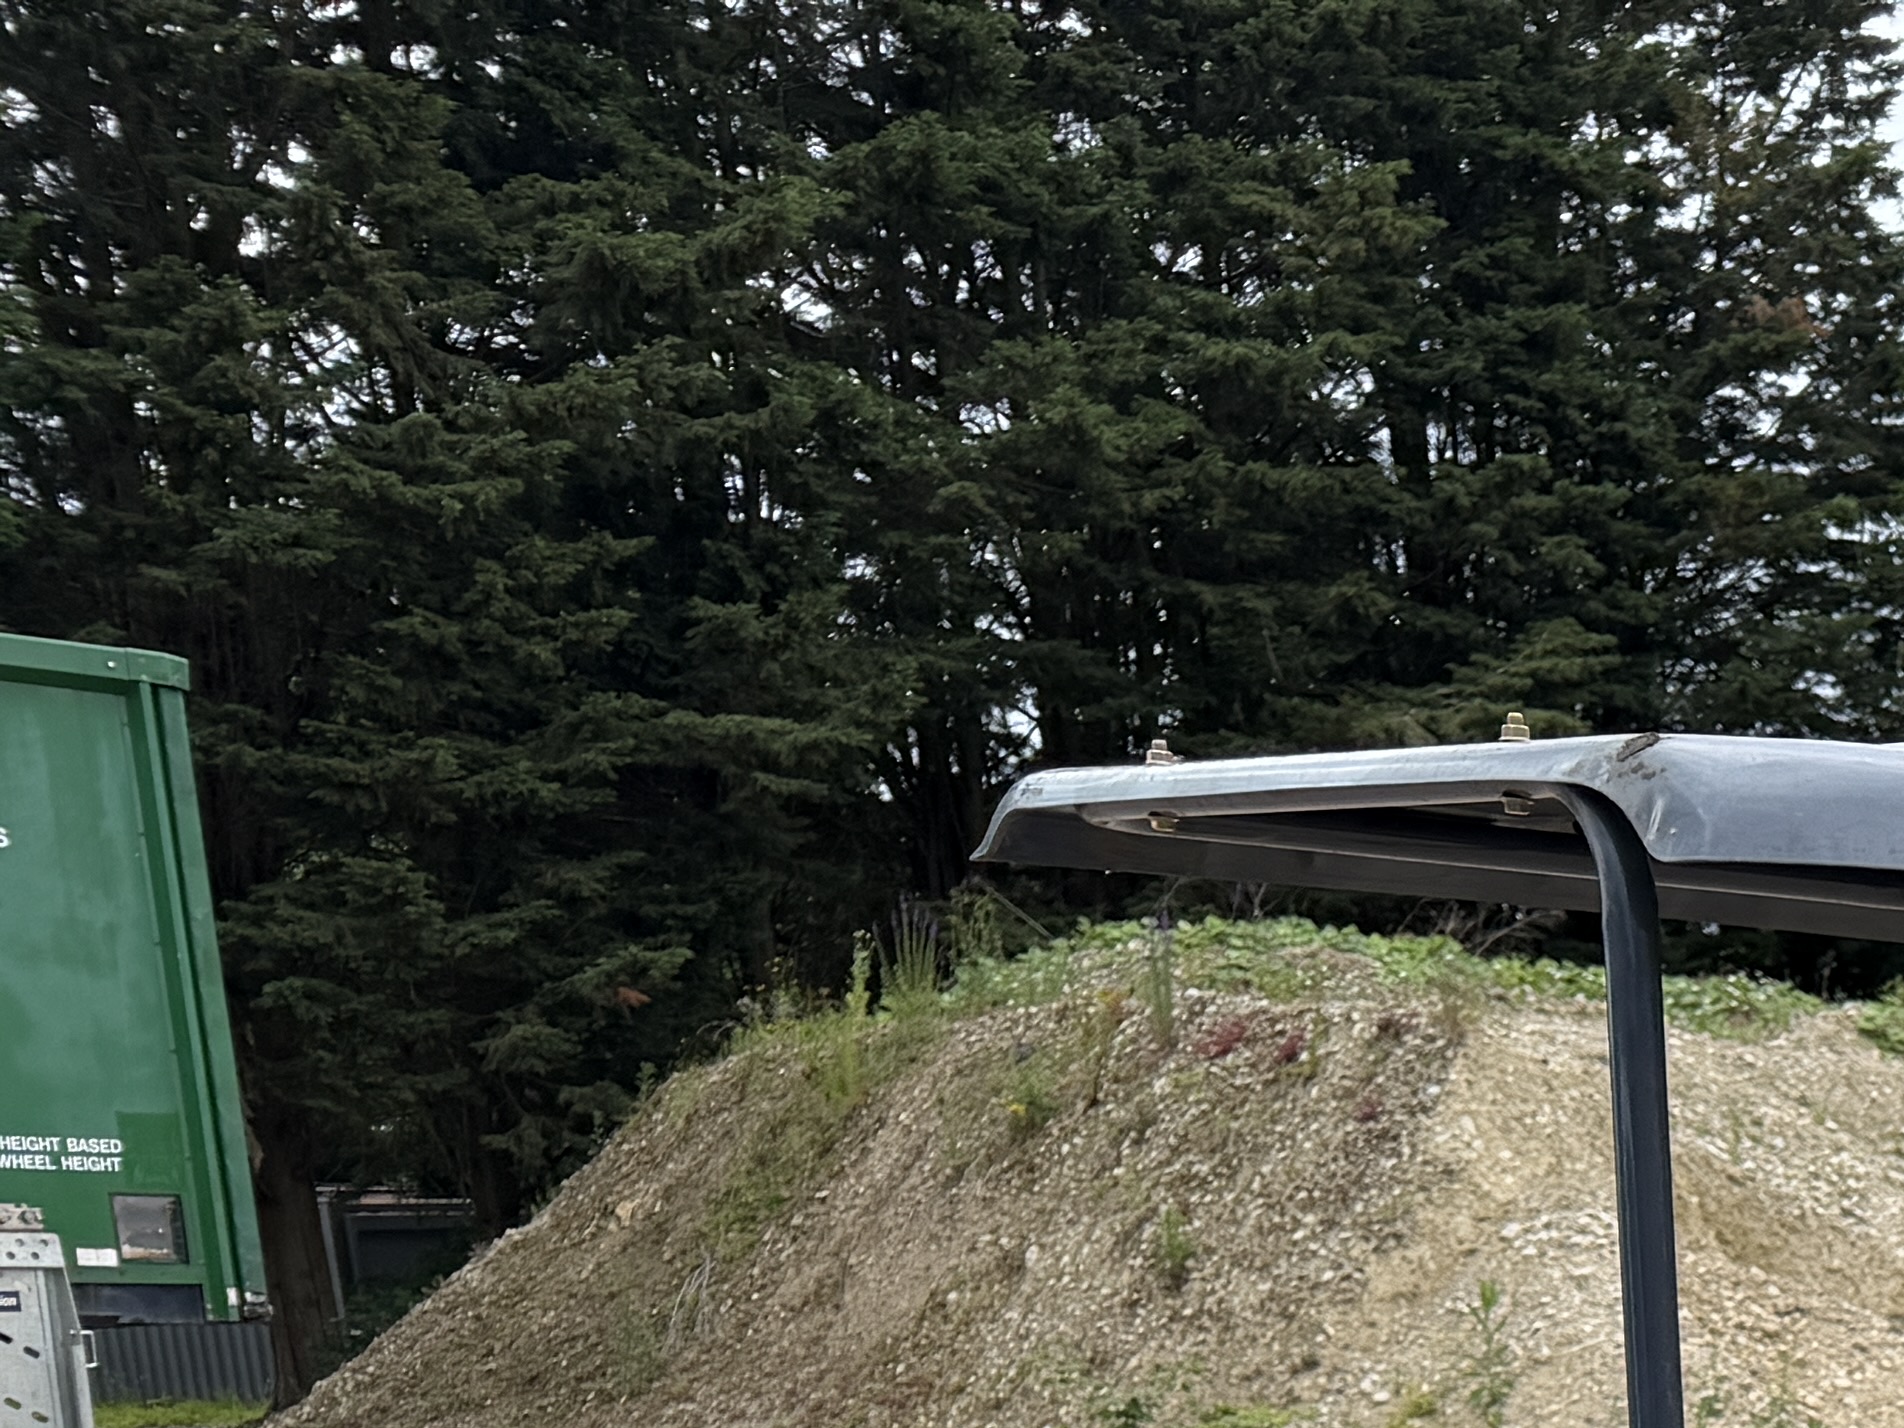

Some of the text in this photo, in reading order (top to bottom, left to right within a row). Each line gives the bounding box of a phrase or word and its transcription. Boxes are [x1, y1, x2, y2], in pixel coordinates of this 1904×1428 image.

[0, 1136, 123, 1154] HEIGHT BASED
[60, 1156, 122, 1172] HEIGHT
